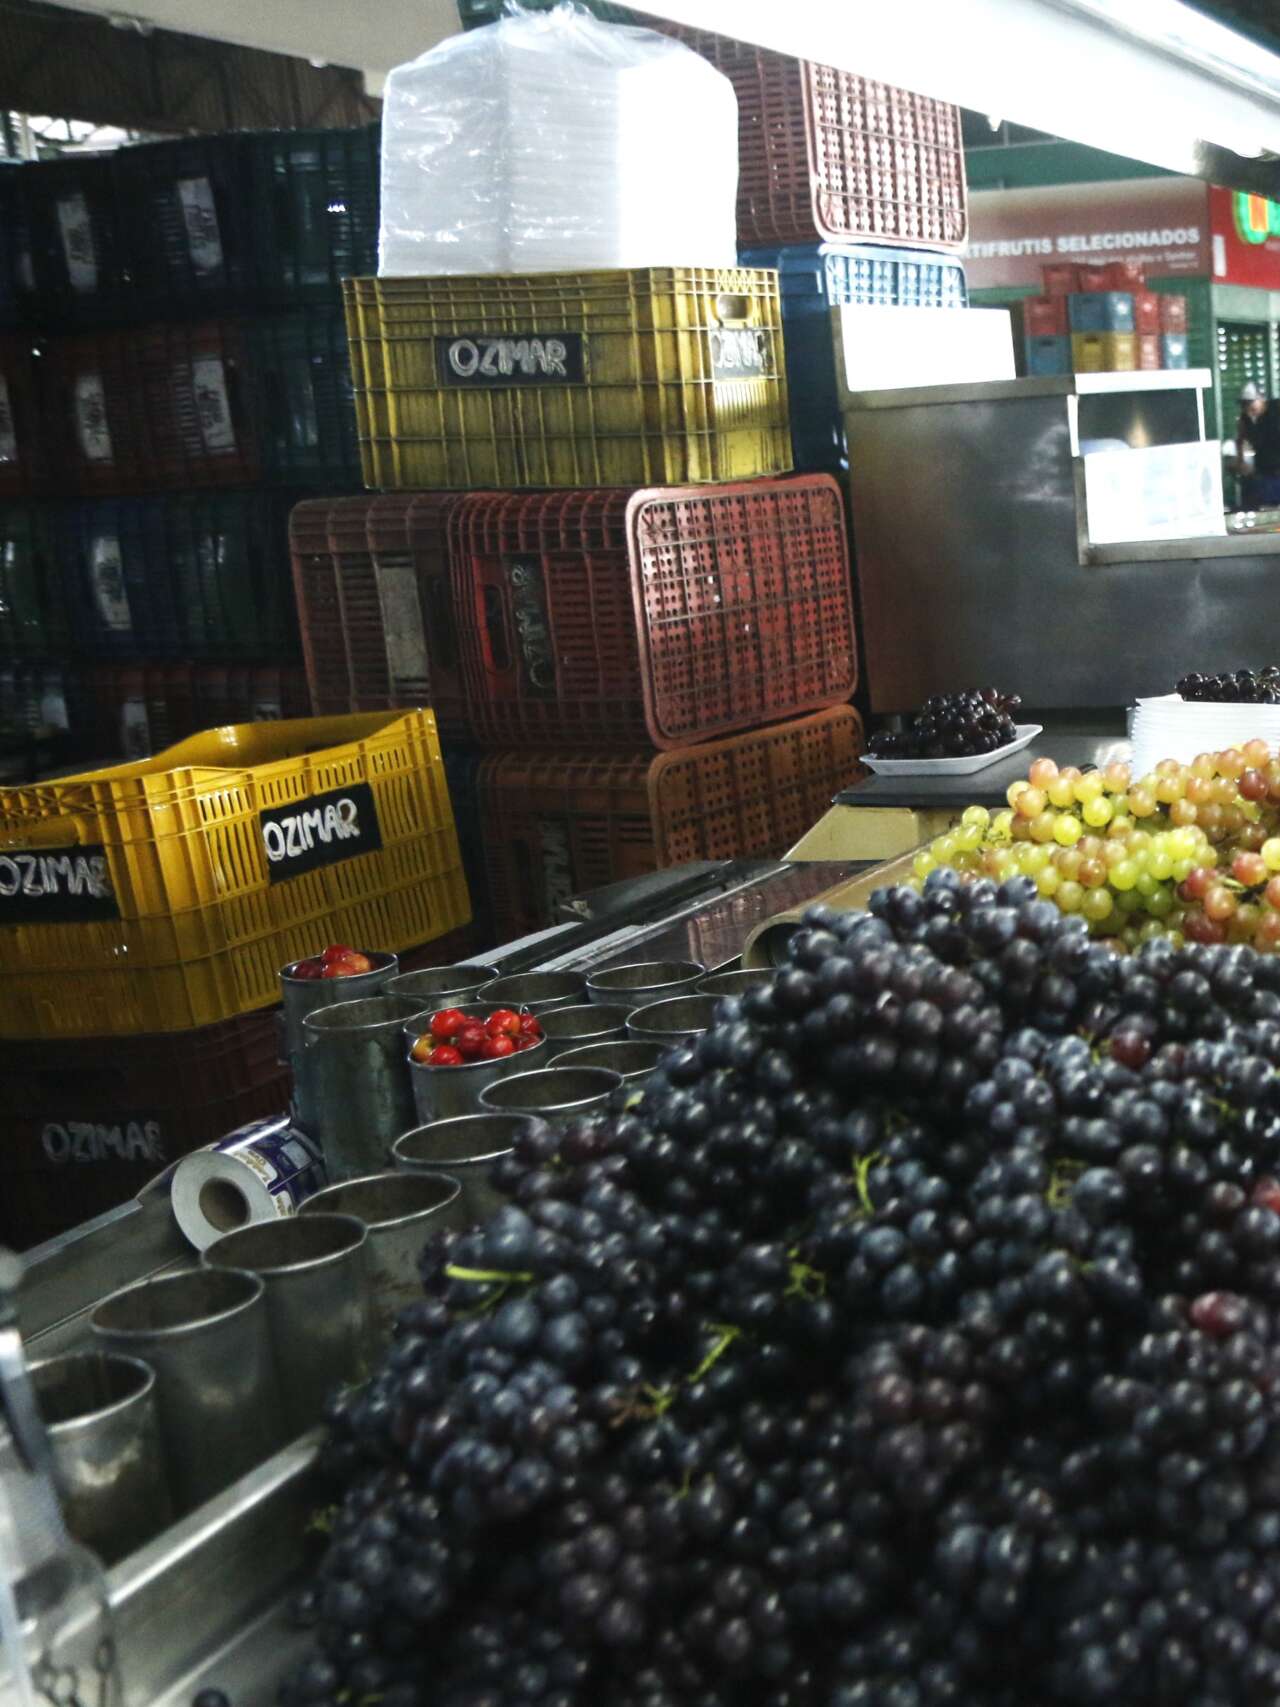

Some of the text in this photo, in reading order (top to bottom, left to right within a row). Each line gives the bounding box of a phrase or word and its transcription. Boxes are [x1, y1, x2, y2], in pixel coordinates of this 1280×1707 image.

[1057, 228, 1200, 253] SELECIONADOS
[450, 339, 567, 377] OZIMAR
[262, 798, 360, 862] OZIMAR
[42, 1121, 168, 1163] OZIMAR
